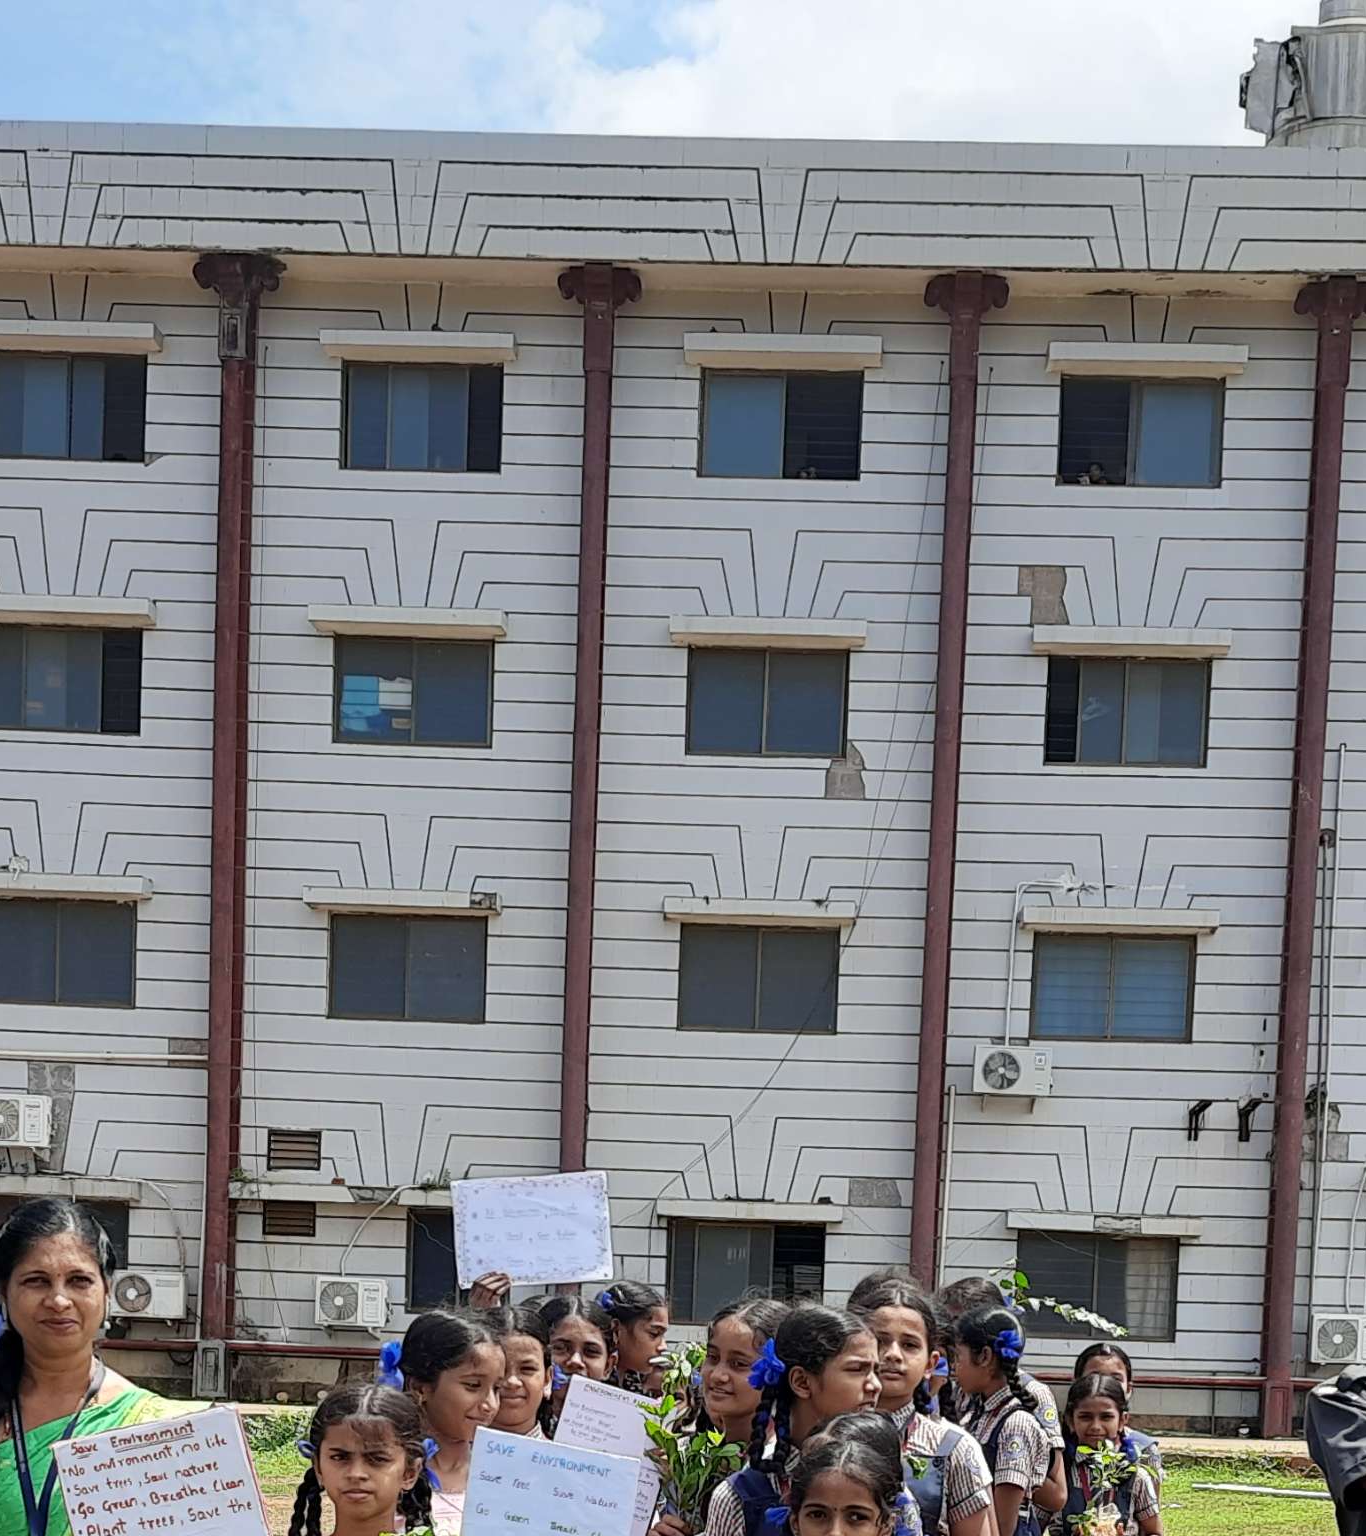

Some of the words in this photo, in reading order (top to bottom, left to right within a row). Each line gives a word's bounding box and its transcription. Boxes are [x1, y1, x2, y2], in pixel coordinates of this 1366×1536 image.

[71, 1441, 98, 1456] Save
[110, 1420, 194, 1448] Environment
[182, 1442, 200, 1453] no
[205, 1433, 228, 1449] life
[486, 1440, 516, 1457] SAVE
[73, 1483, 99, 1496] Save
[175, 1461, 219, 1479] nature
[149, 1484, 207, 1505] Breathe
[187, 1507, 221, 1522] Save
[227, 1498, 252, 1514] the
